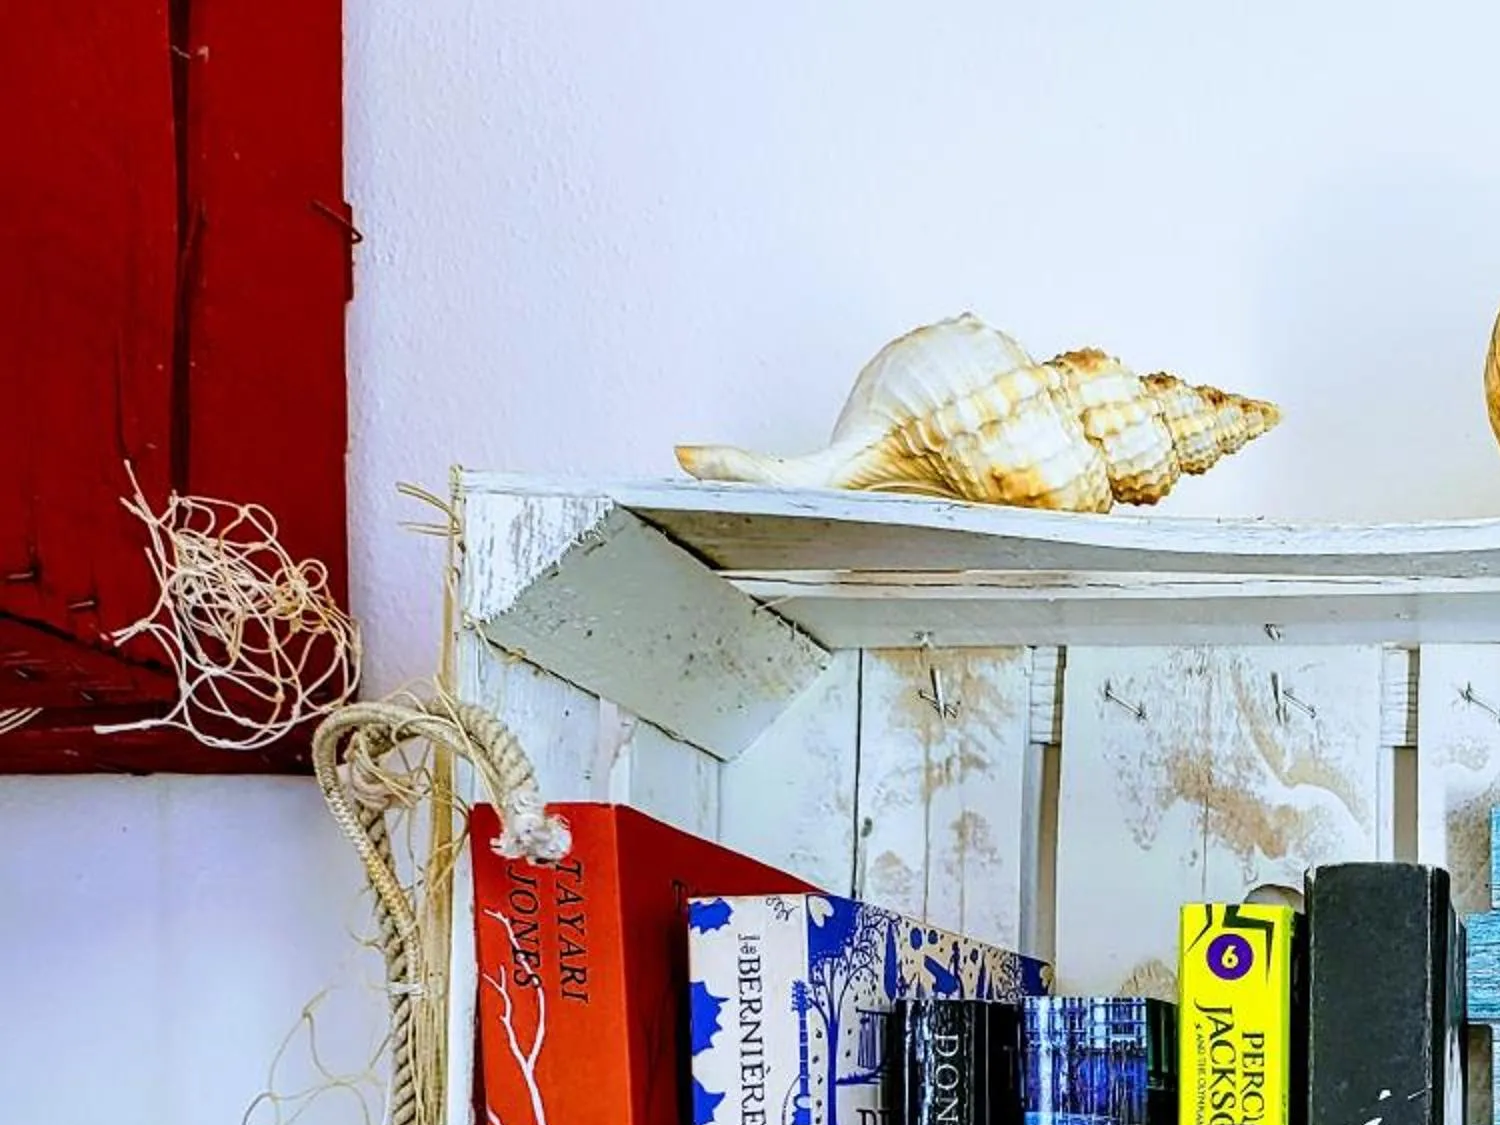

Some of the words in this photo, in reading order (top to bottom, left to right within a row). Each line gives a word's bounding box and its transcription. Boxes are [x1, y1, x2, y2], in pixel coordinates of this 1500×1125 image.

[507, 865, 541, 987] JONES
[555, 858, 589, 1004] TAYARI
[1221, 945, 1239, 969] 6
